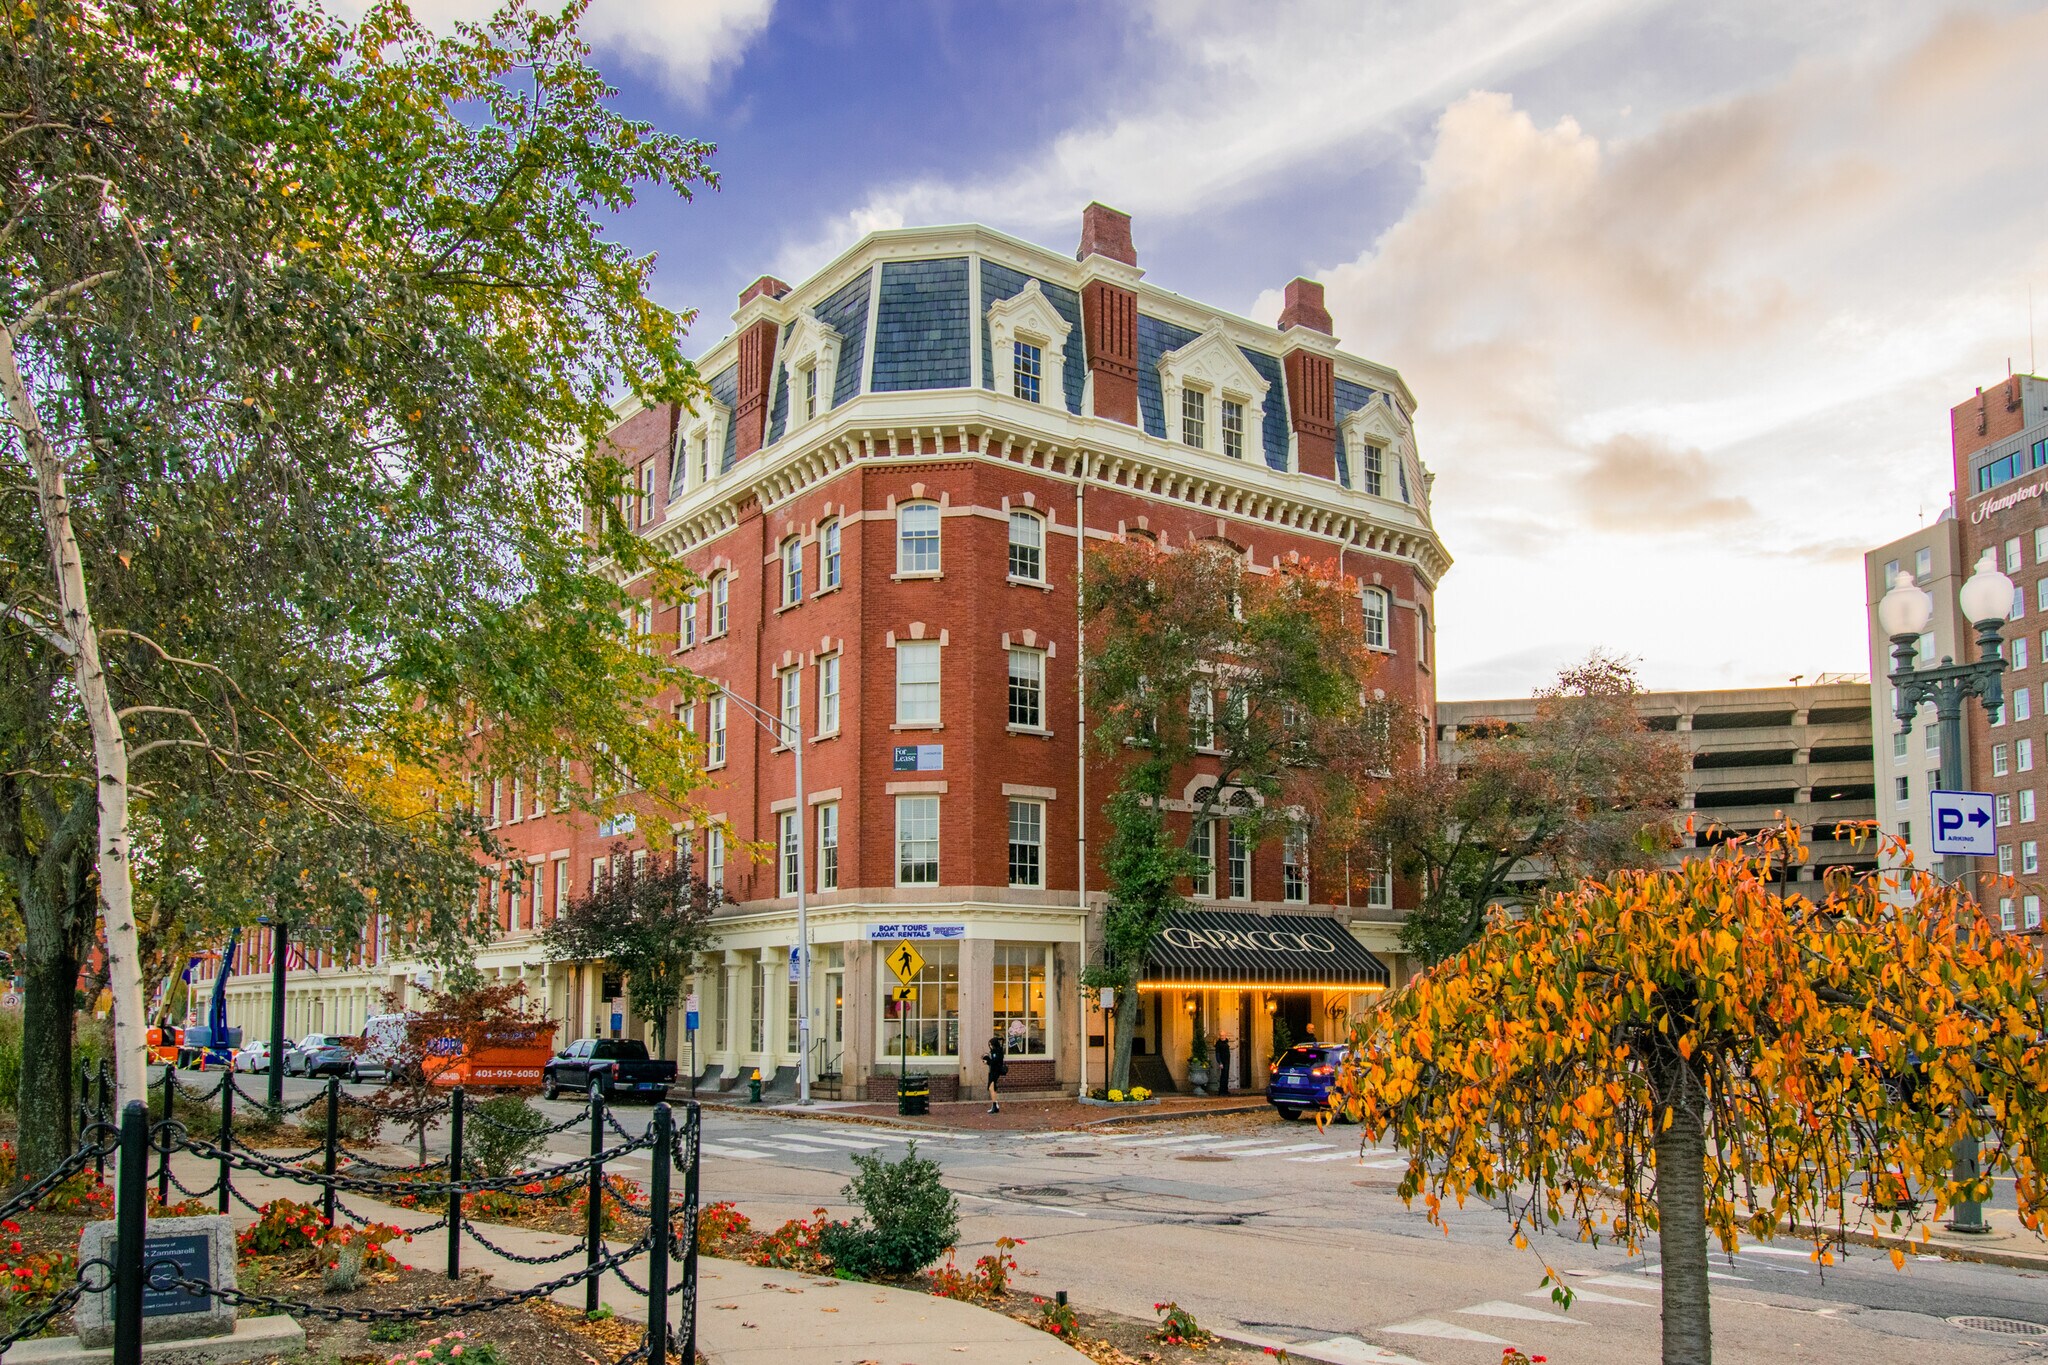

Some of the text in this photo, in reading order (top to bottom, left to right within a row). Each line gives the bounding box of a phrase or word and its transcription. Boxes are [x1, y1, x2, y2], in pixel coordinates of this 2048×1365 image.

[1971, 483, 2044, 524] Hampton
[1163, 927, 1335, 953] CAPRICCIO
[151, 1247, 195, 1257] Zammarelli
